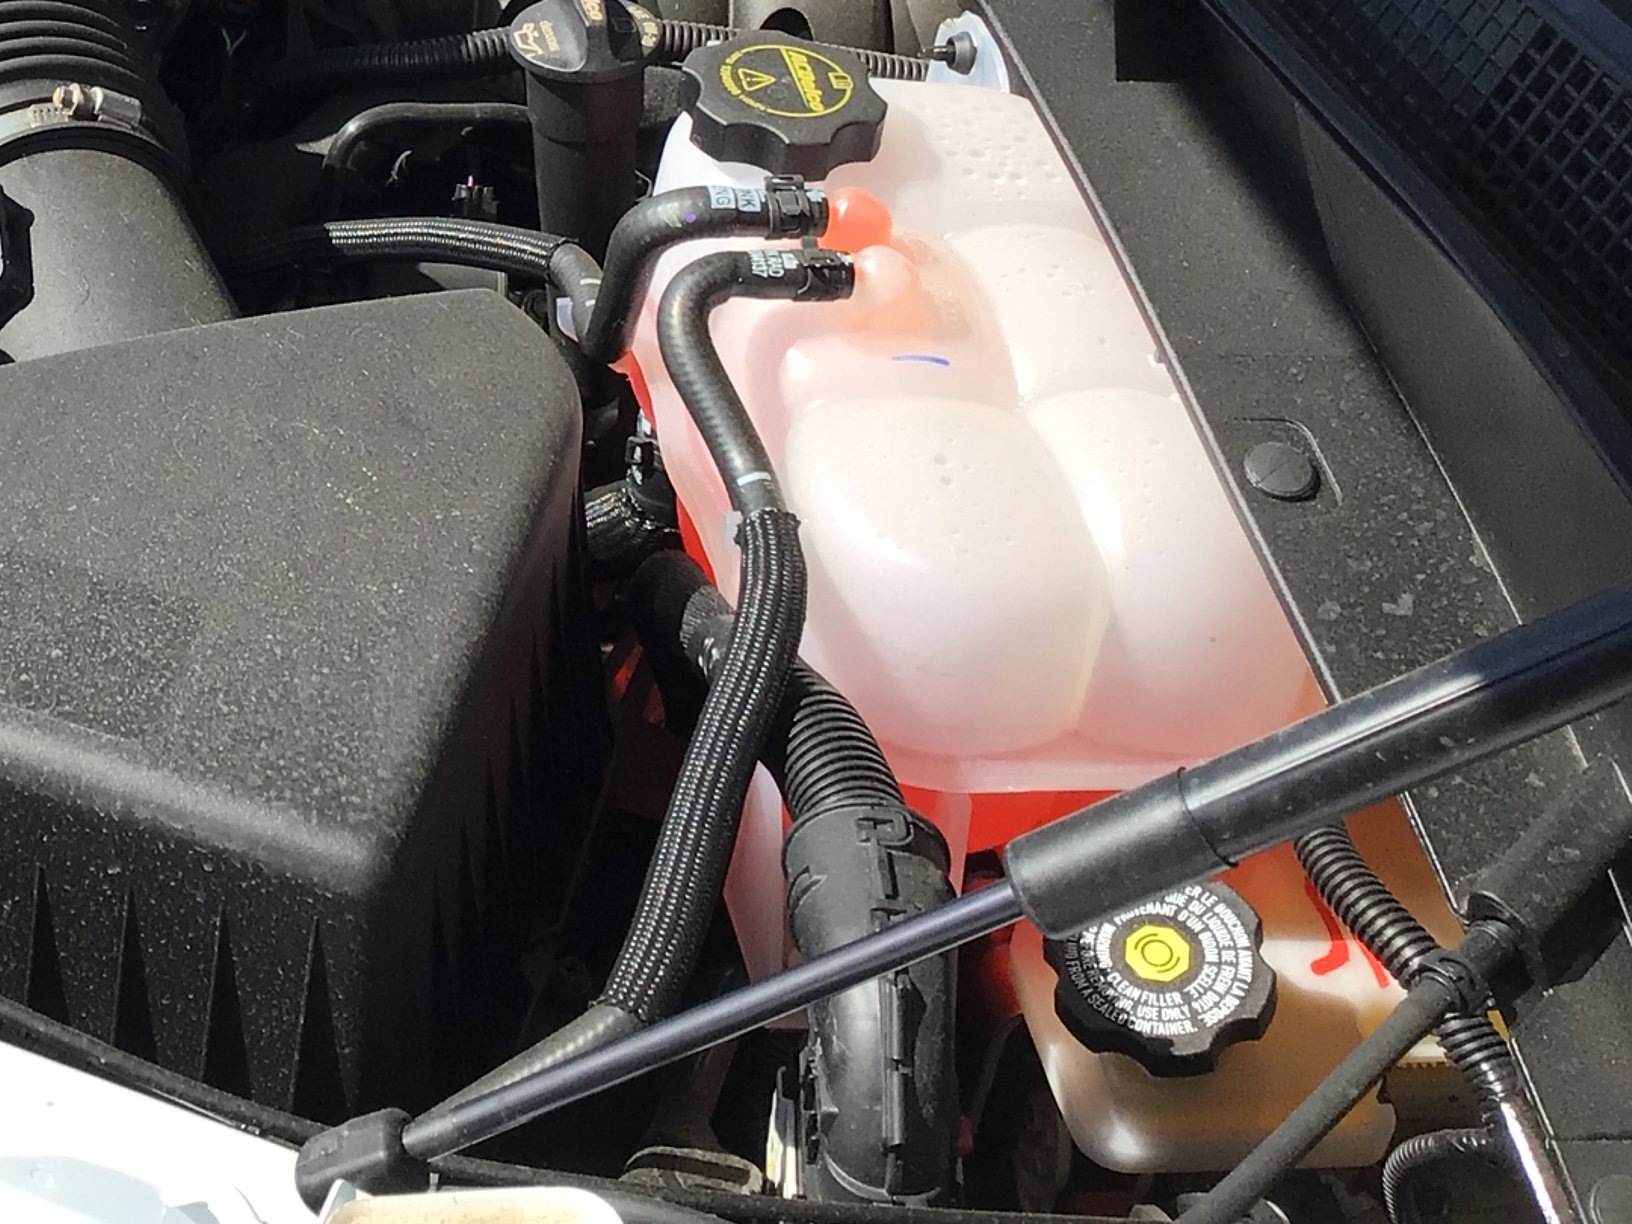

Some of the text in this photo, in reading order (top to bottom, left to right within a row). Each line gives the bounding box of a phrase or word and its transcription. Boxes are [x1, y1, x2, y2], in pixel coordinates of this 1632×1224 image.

[1213, 902, 1250, 948] BOUCHON
[1066, 959, 1092, 990] FROM
[1087, 994, 1128, 1026] SEALED
[1128, 1015, 1199, 1036] CONTAINER.
[1106, 971, 1142, 1002] CLEAN
[1140, 991, 1184, 1007] FILLER
[1136, 1004, 1160, 1021] USE
[1161, 1004, 1191, 1022] ONLY
